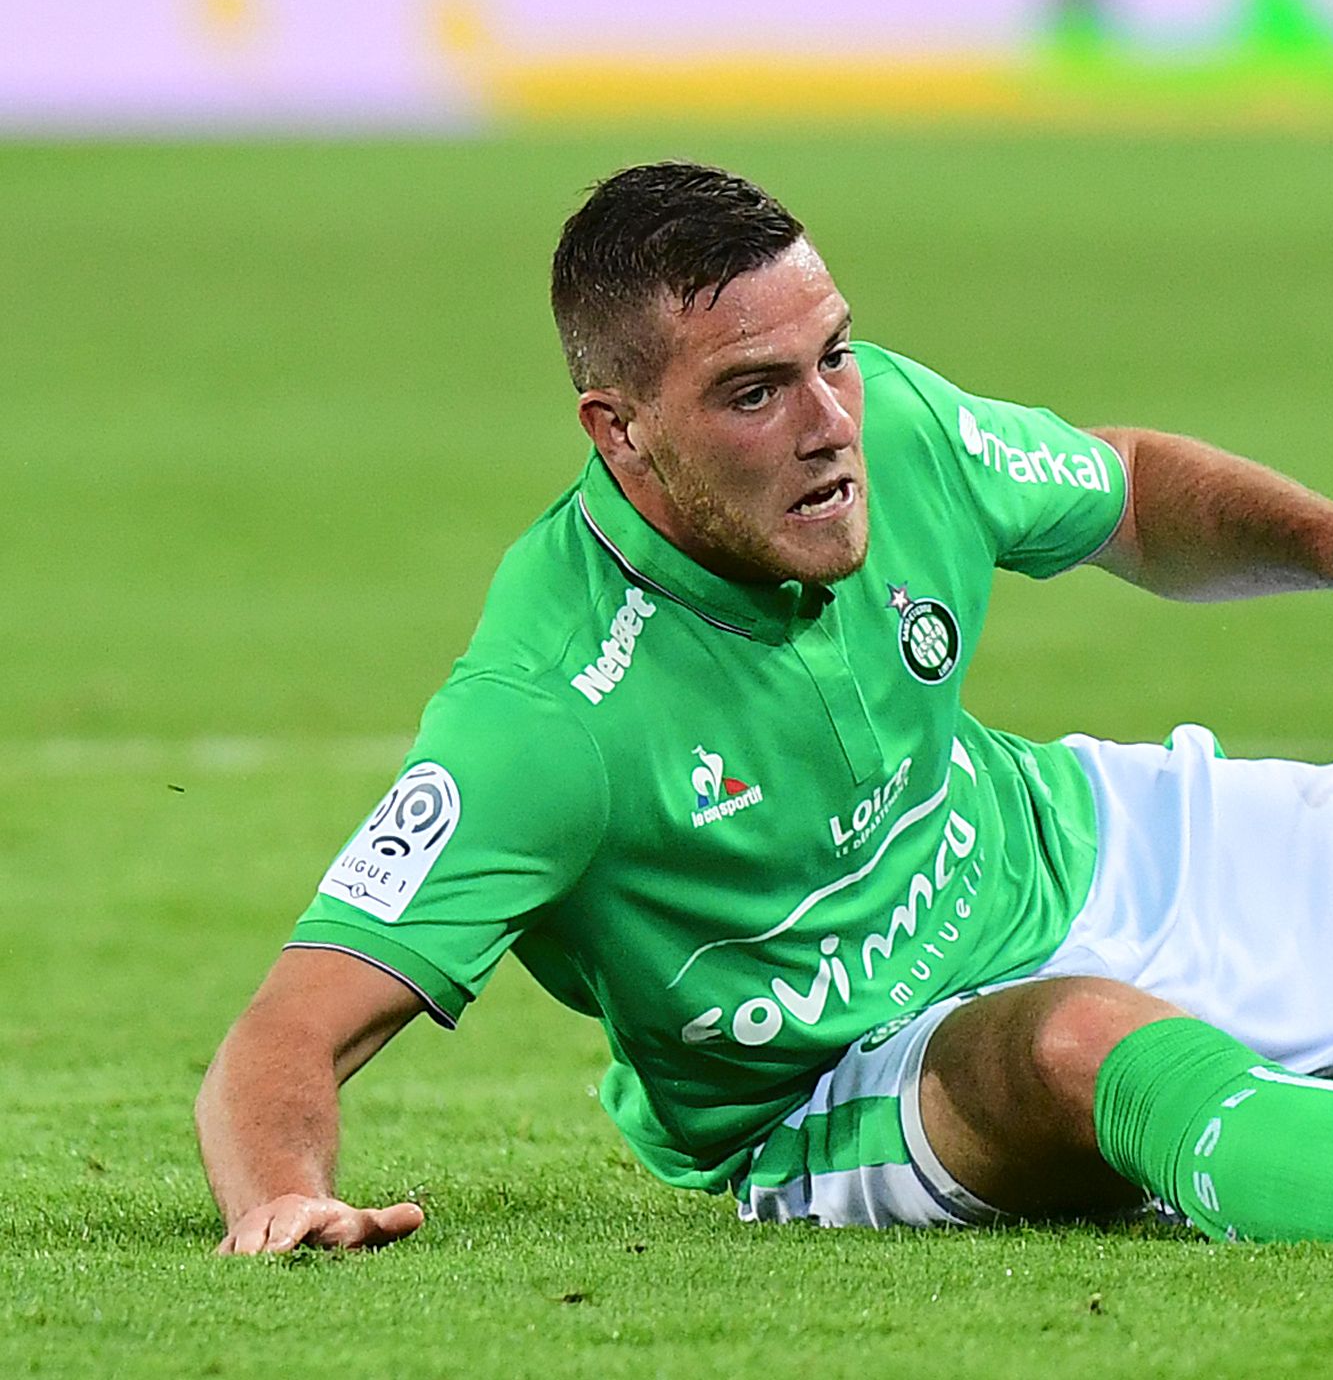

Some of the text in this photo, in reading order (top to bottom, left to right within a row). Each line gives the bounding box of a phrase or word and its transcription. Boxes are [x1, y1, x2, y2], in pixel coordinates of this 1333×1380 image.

[981, 428, 1110, 493] markal
[570, 587, 657, 706] NetBet
[341, 855, 407, 894] LIGUE 1
